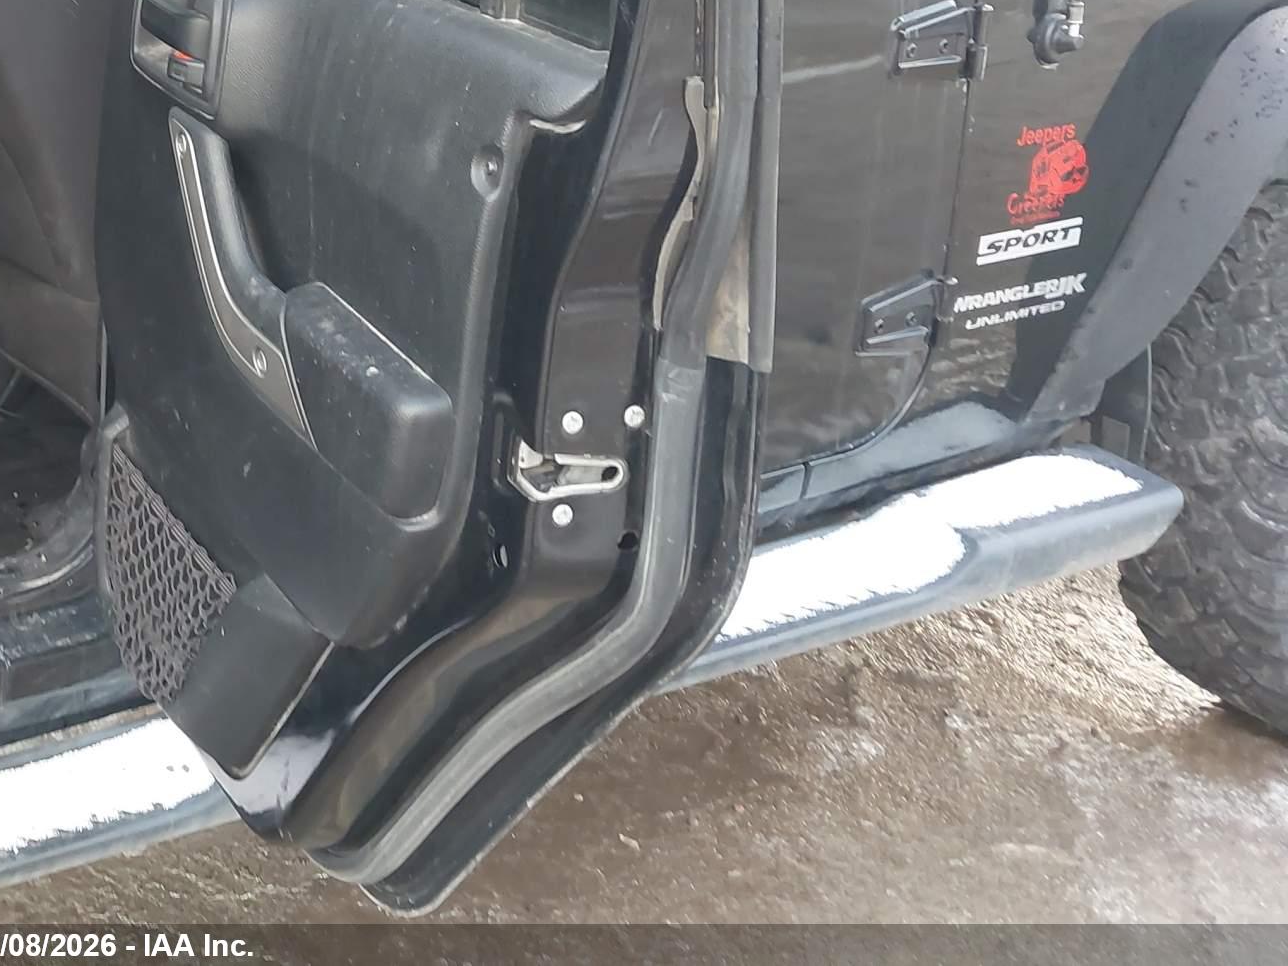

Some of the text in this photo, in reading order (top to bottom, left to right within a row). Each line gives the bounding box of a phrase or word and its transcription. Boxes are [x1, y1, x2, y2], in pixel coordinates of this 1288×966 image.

[1016, 123, 1076, 146] Jeepers
[983, 226, 1074, 254] SPORT
[965, 299, 1066, 330] UNLIMITED
